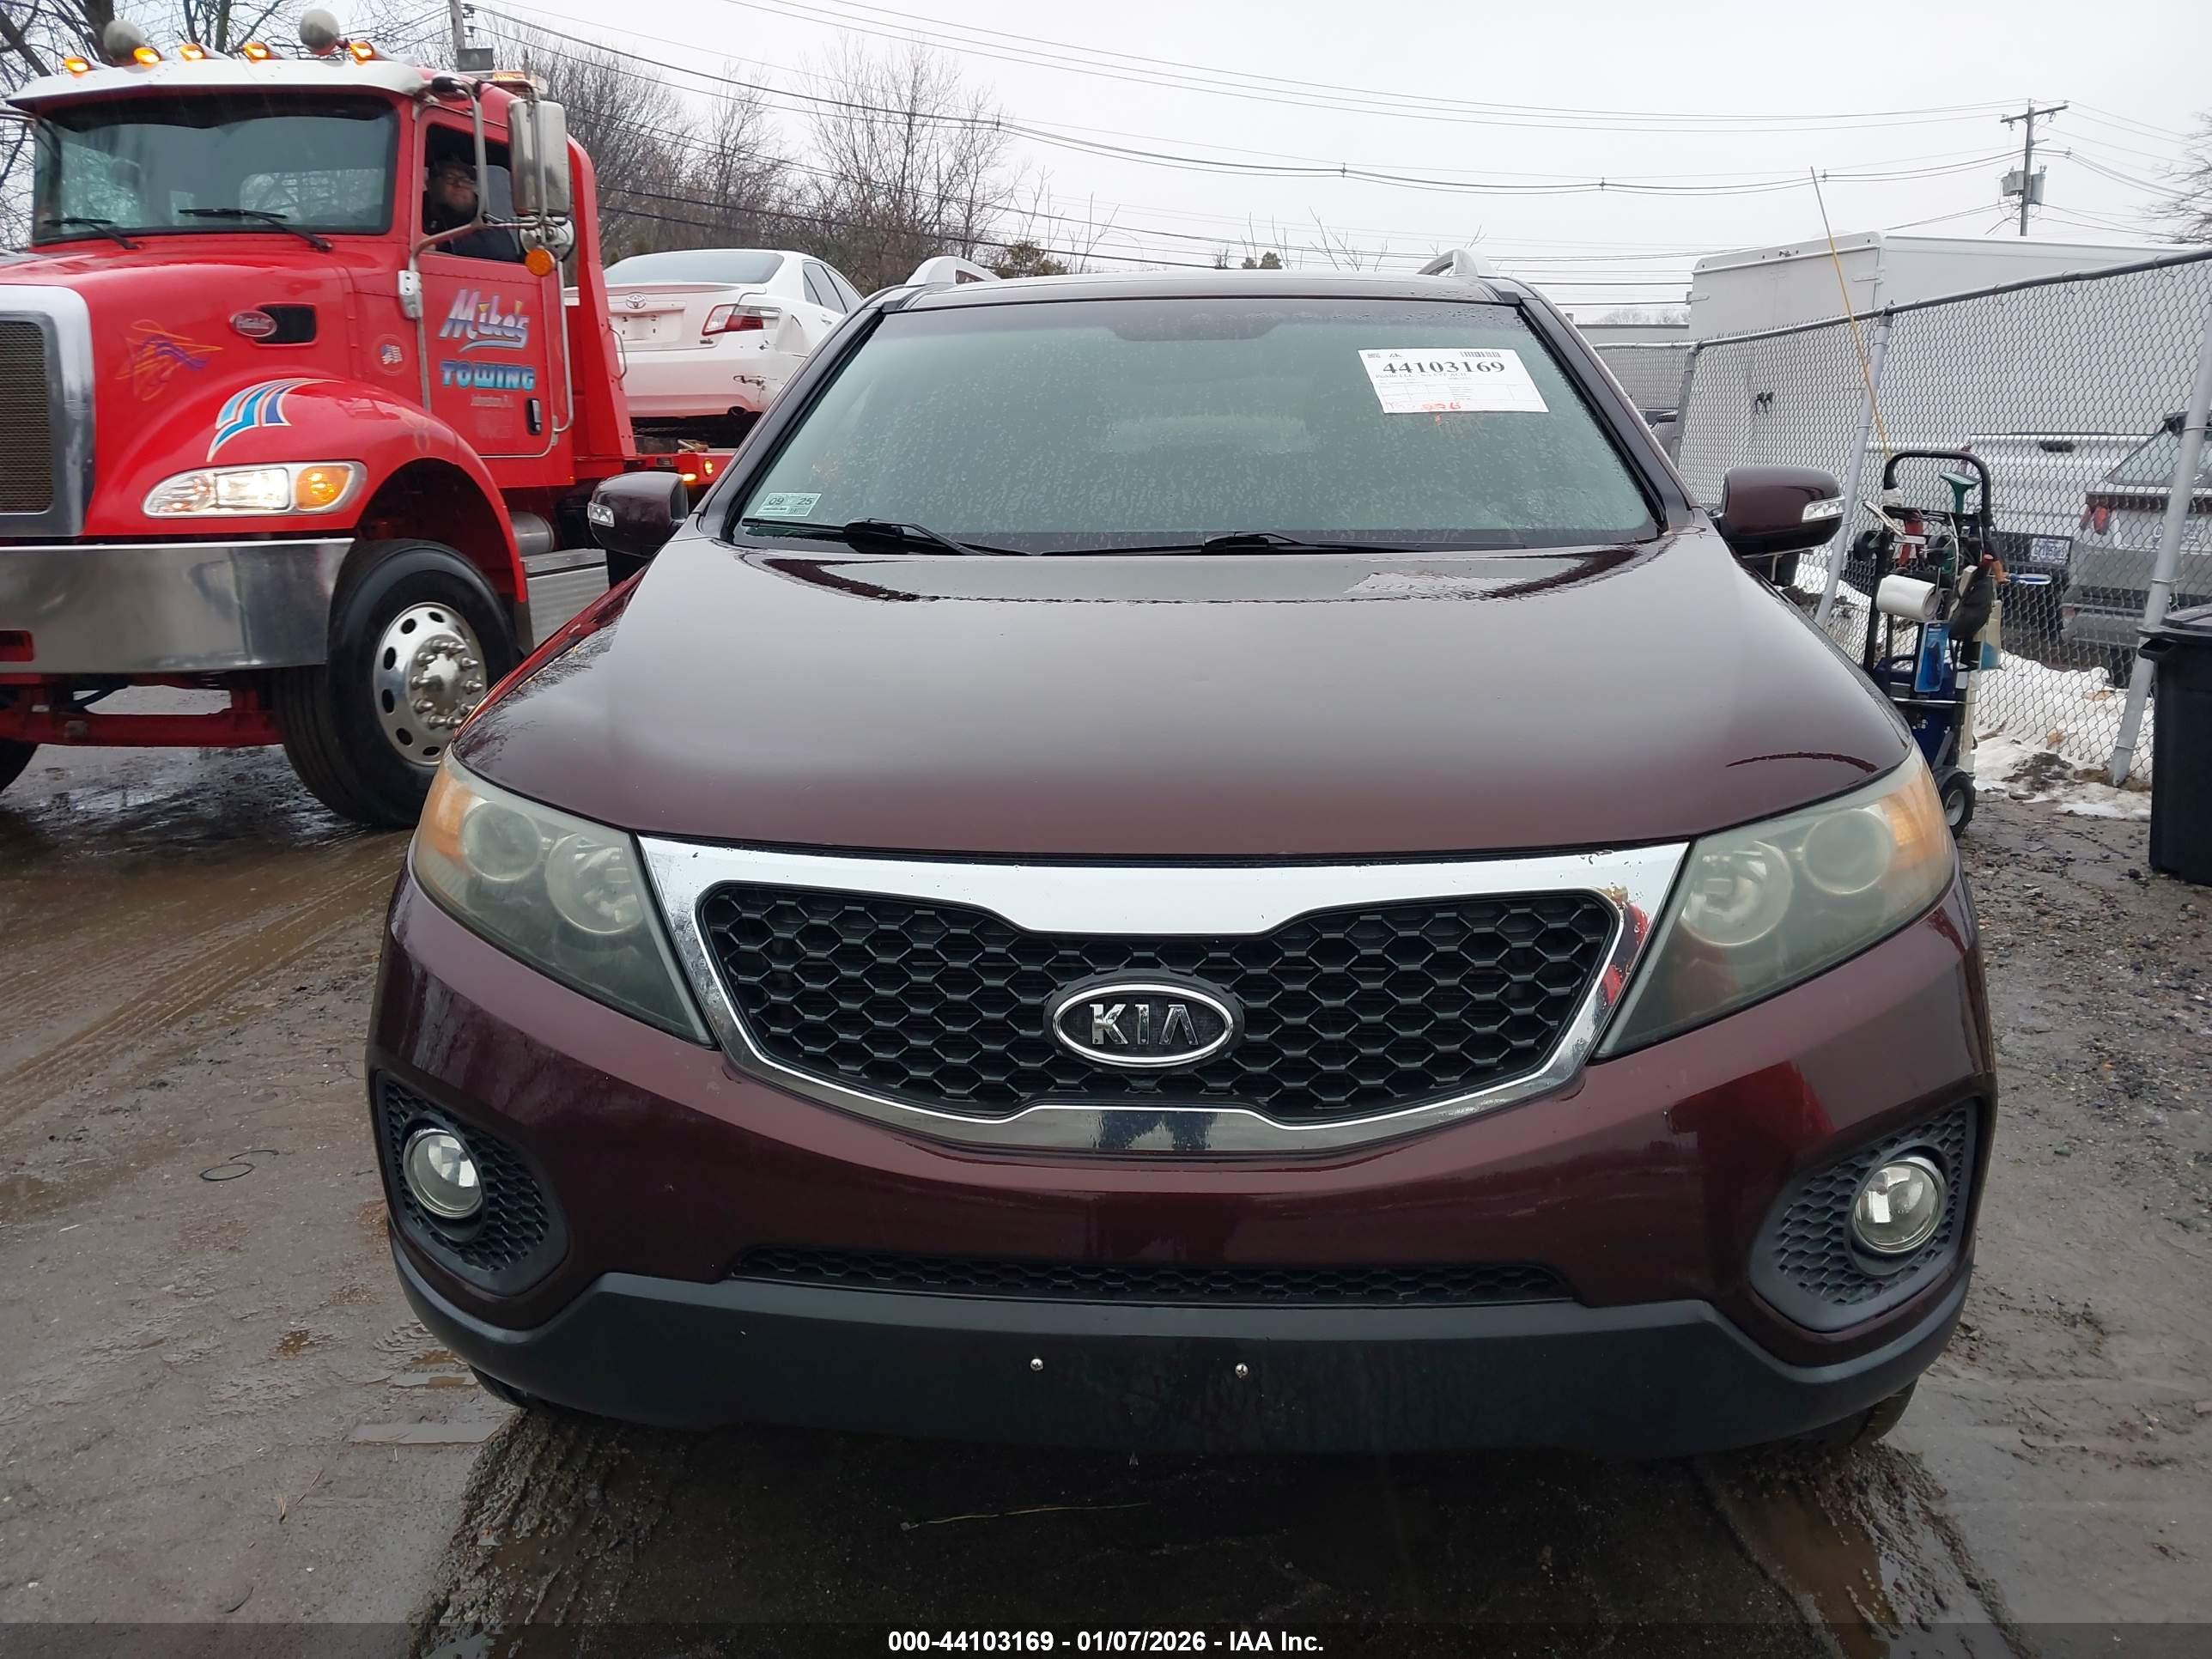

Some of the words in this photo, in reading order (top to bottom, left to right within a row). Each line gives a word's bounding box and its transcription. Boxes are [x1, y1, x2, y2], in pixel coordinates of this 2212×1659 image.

[439, 289, 530, 351] Mike's
[440, 359, 536, 392] TOWING
[1382, 361, 1505, 374] 44103169
[769, 497, 785, 506] 09
[797, 497, 812, 506] 25
[1089, 1003, 1200, 1045] KIA
